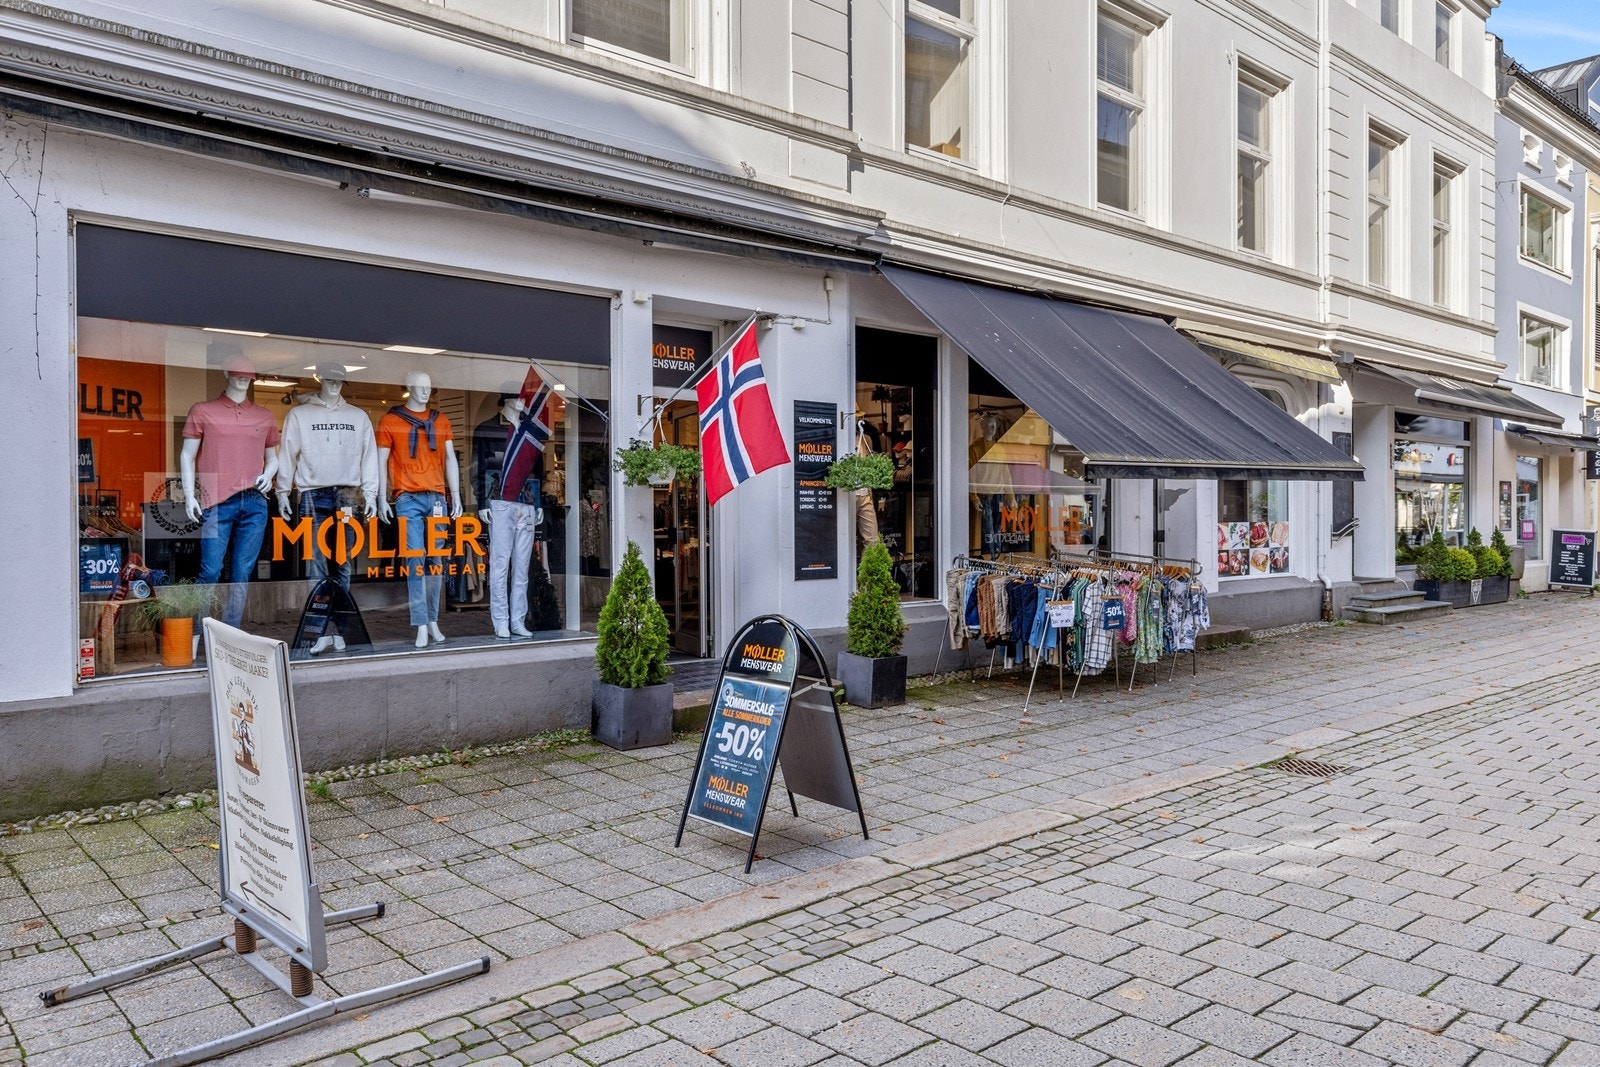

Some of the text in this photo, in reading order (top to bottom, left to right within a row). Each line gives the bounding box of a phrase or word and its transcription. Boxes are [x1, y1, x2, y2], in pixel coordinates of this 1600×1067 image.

[653, 359, 695, 371] ENSWEAR
[80, 383, 144, 421] LLER
[311, 423, 355, 432] HILFIGER
[798, 443, 832, 455] MØLLER
[799, 454, 832, 462] MENSWEAR
[83, 559, 119, 575] -30%
[367, 564, 486, 578] MENSWEAR
[1105, 605, 1121, 617] -50%
[743, 643, 785, 662] MØLLER
[740, 657, 782, 673] MENSWEAR
[722, 708, 735, 718] ALLE
[725, 696, 775, 716] SOMMERSALG
[715, 721, 766, 761] -50%
[708, 774, 749, 798] MØLLER
[705, 789, 746, 809] MENSWEAR
